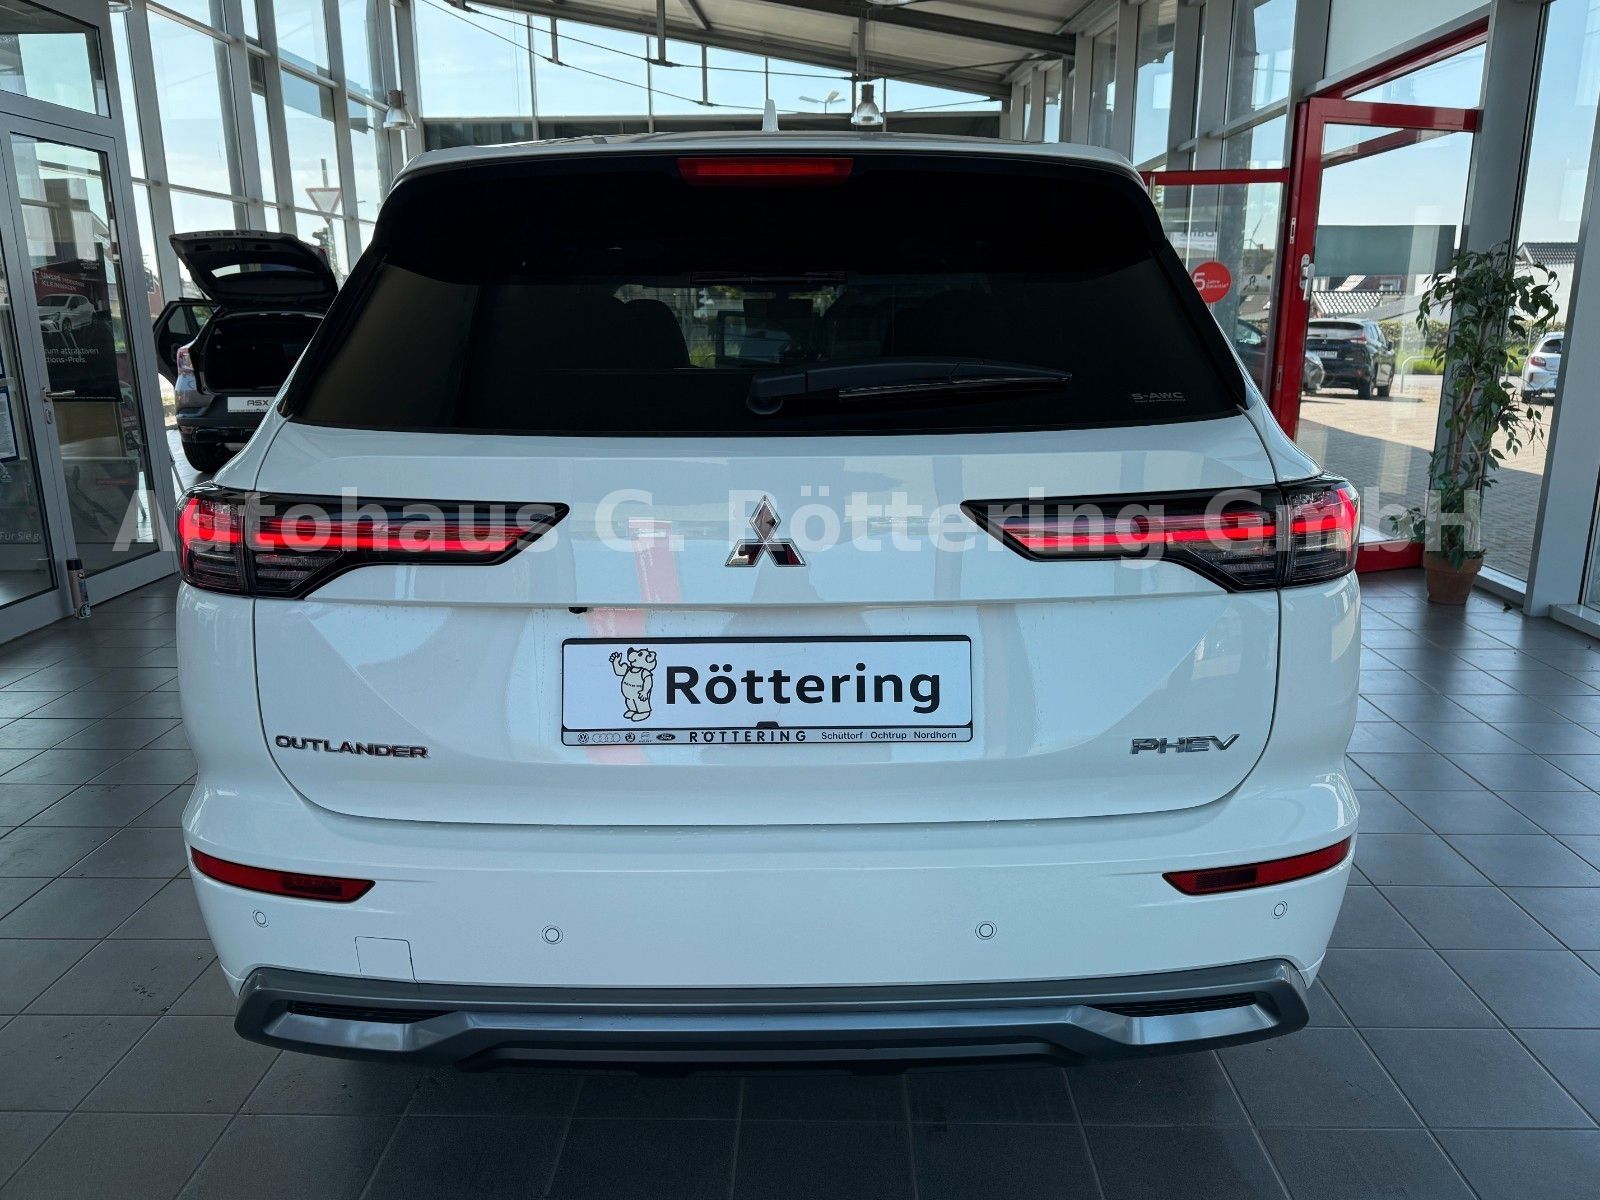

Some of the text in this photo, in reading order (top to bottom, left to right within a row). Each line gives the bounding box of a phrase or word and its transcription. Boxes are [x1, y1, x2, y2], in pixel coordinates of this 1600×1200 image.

[1193, 272, 1206, 290] 5
[247, 399, 269, 407] ASX
[1131, 391, 1184, 400] S-AWC
[665, 662, 941, 715] Röttering
[689, 730, 807, 743] RÖTTERING
[821, 731, 957, 741] Schüttorf Ochtrup Nordhorn
[275, 734, 430, 759] OUTLANDER
[1130, 733, 1241, 755] PHEV
